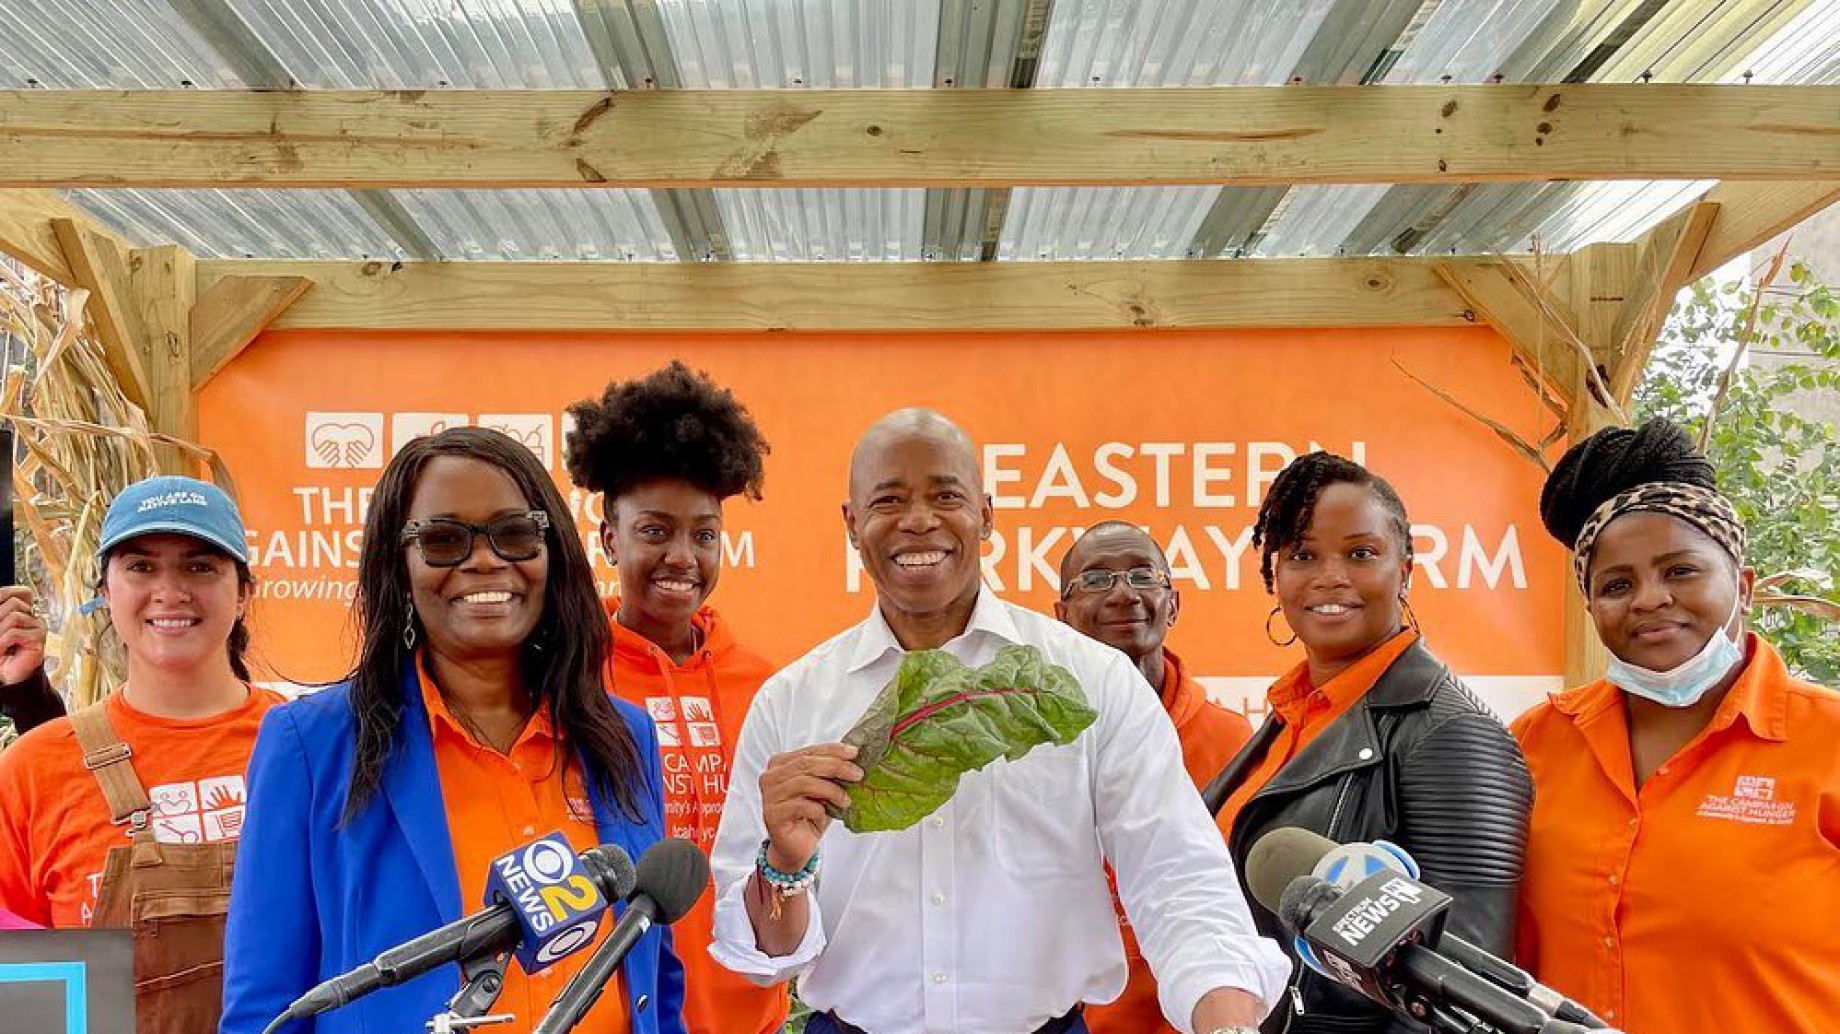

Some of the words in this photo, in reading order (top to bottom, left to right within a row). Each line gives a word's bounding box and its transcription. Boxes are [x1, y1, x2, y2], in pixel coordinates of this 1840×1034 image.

[244, 529, 365, 568] GAINS
[496, 854, 555, 932] NEWS
[539, 874, 598, 922] 2
[1340, 892, 1401, 946] NEWS
